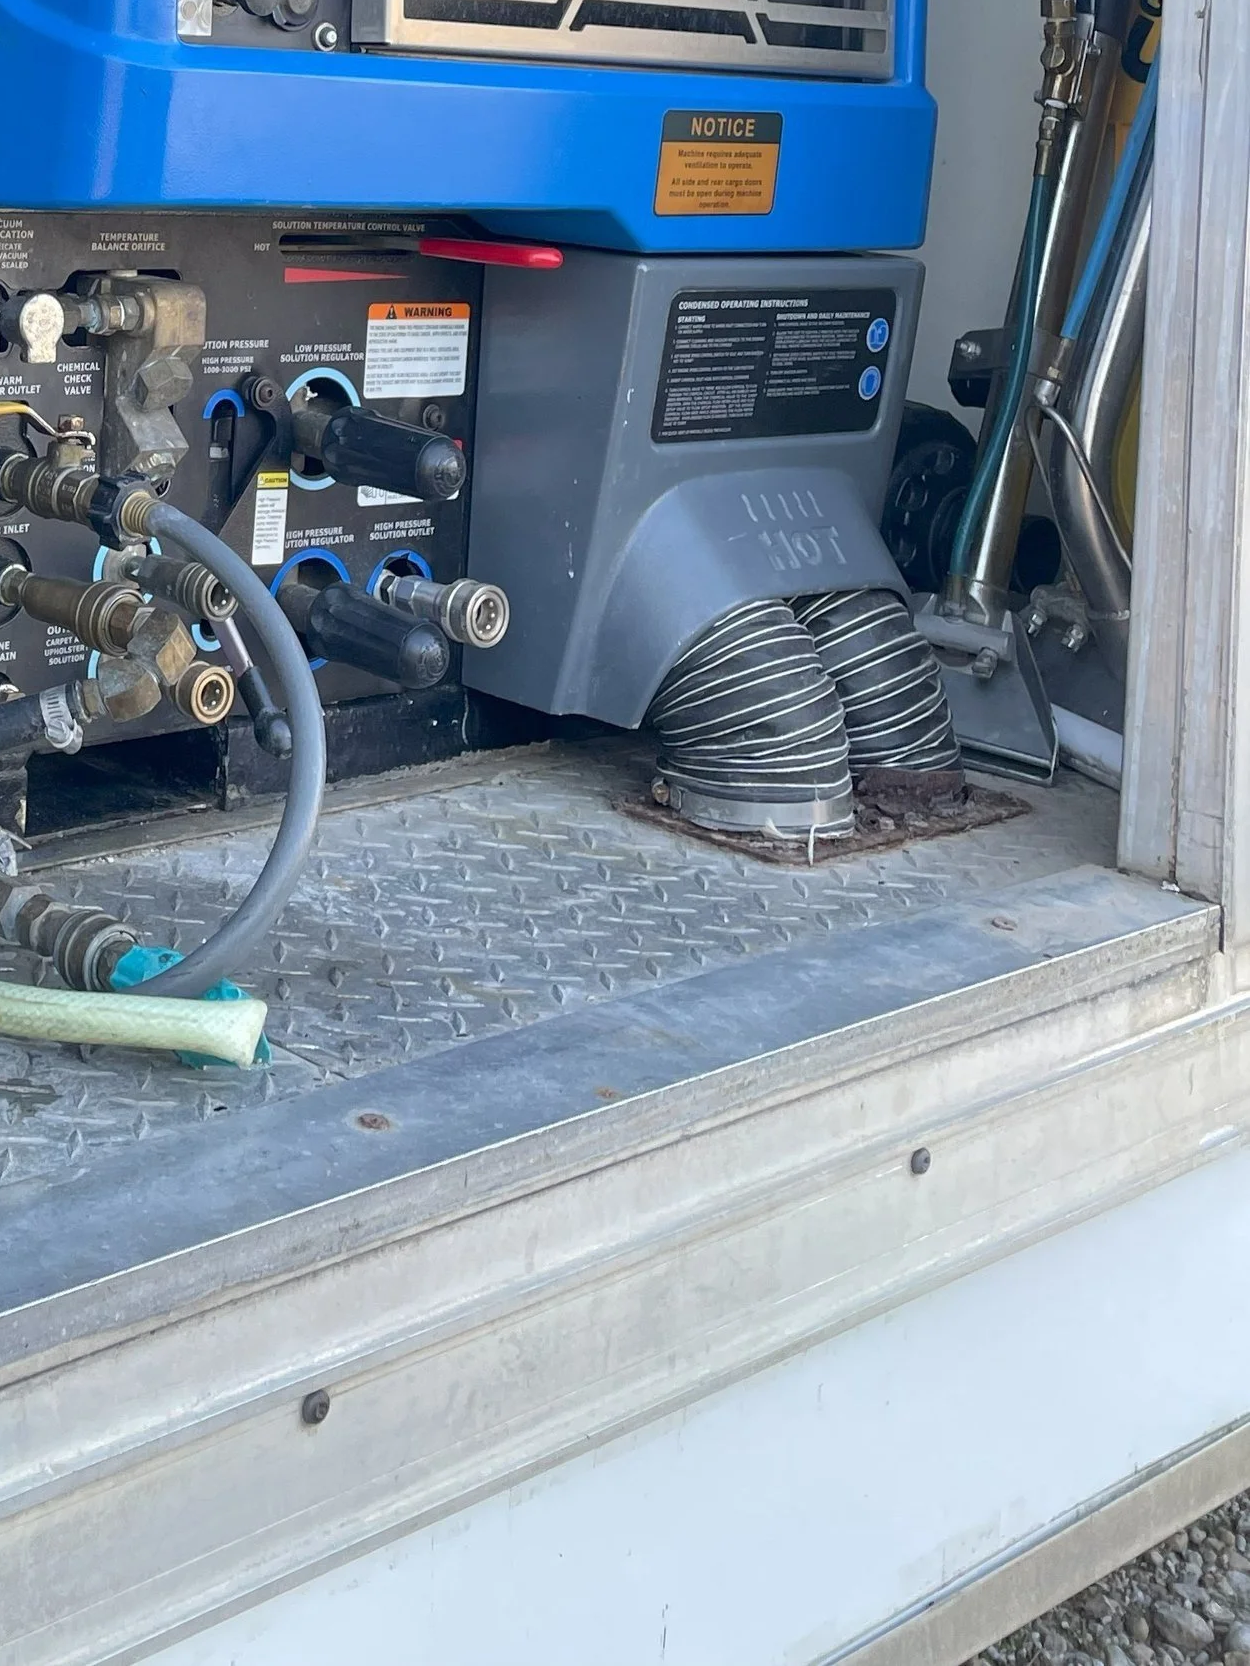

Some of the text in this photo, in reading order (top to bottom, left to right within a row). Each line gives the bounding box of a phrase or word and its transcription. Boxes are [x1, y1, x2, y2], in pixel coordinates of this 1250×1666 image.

[691, 117, 756, 137] NOTICE
[678, 149, 762, 159] Machine requires adequate
[685, 161, 719, 169] ventilation
[671, 178, 681, 186] All
[682, 178, 695, 186] side
[697, 178, 709, 186] and
[725, 179, 743, 188] cargo
[744, 178, 762, 186] doors
[687, 189, 695, 197] be
[696, 190, 712, 199] open
[714, 189, 735, 199] during
[736, 189, 762, 197] machine
[272, 221, 426, 232] SOLUTION TEMPERATURE CONTROL VALVE
[100, 232, 159, 242] TEMPERATURE
[91, 242, 165, 252] BALANCE ORIFICE
[254, 243, 271, 252] HOT
[1, 261, 28, 270] SEALED
[678, 299, 809, 310] CONDENSED OPERATING INSTRUCTIONS
[404, 307, 452, 317] WARNING
[677, 315, 706, 323] STARTING
[229, 339, 269, 349] PRESSURE
[294, 344, 352, 353] LOW PRESSURE
[202, 356, 254, 364] HIGH PRESSURE
[280, 353, 320, 363] SOLUTION
[320, 352, 365, 362] REGULATOR
[56, 361, 101, 373] CHEMICAL
[239, 365, 252, 373] PSI
[64, 374, 92, 384] CHECK
[7, 385, 42, 396] OUTLET
[64, 386, 91, 396] VALVE
[3, 523, 30, 535] INLET
[374, 518, 432, 531] HIGH PRESSURE
[304, 526, 343, 538] PRESSURE
[369, 527, 435, 541] SOLUTION OUTLET
[310, 534, 355, 546] REGULATOR
[757, 525, 848, 571] HOT
[46, 637, 72, 647] CARPET
[44, 644, 89, 656] UPHOLSTER
[48, 654, 85, 666] SOLUTION
